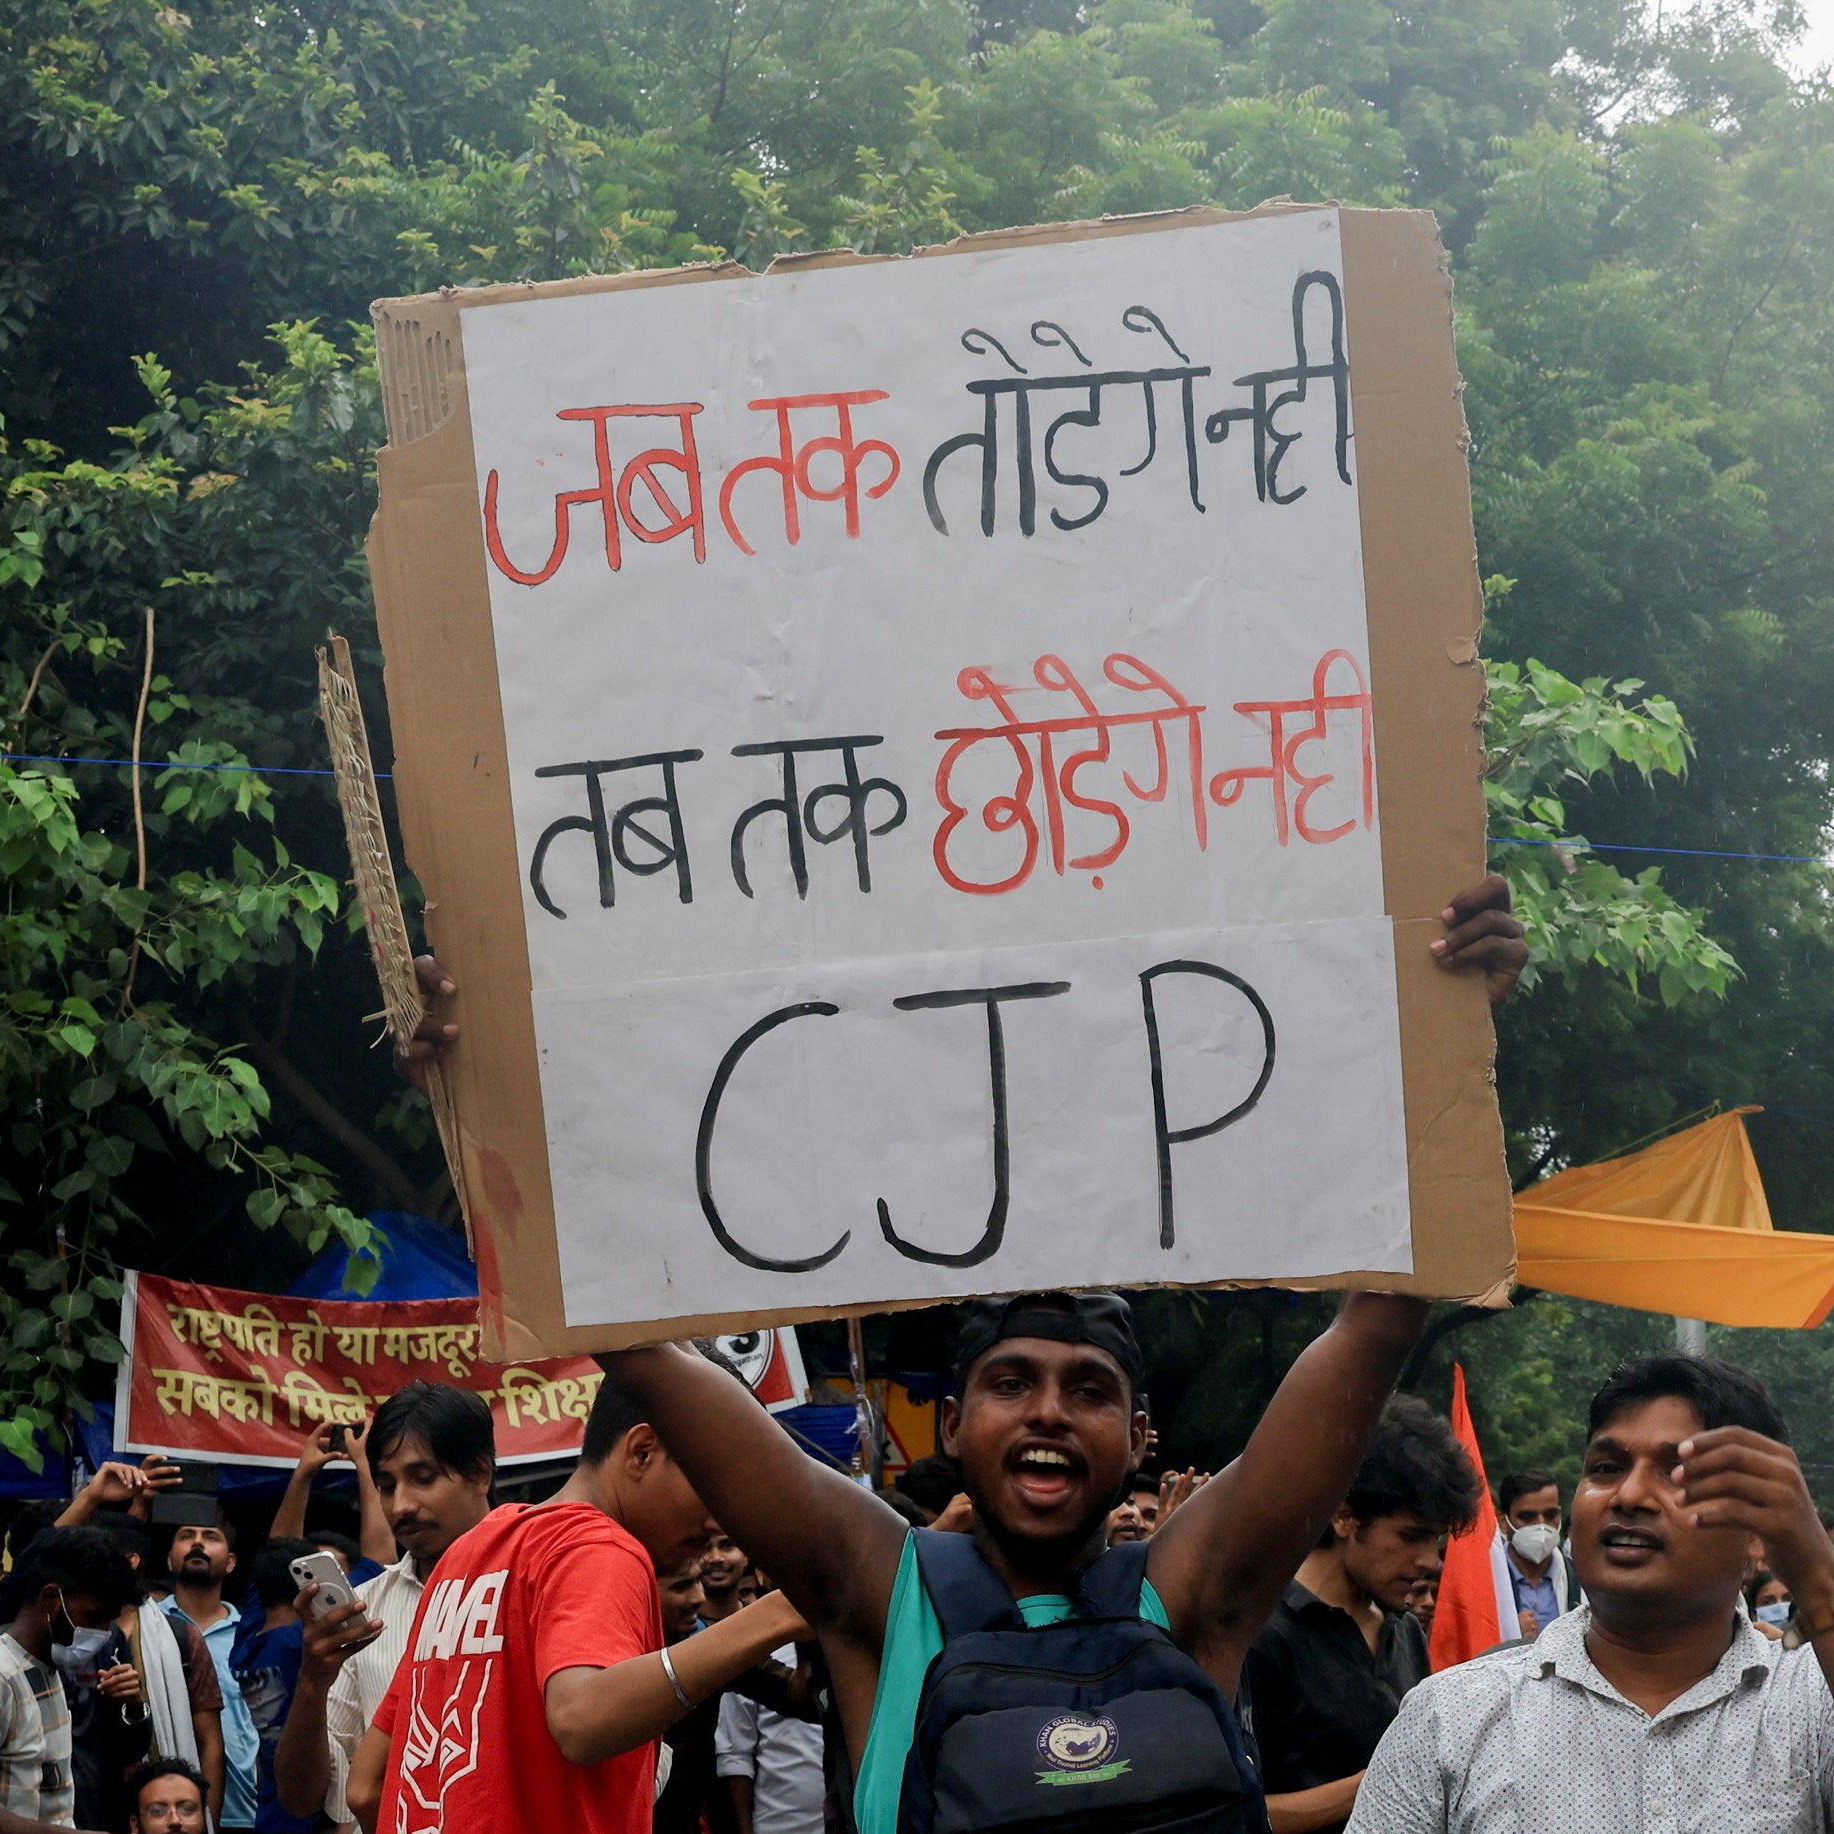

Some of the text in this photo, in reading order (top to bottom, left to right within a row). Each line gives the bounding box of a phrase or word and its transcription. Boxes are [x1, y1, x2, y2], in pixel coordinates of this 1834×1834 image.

[482, 401, 705, 590] जब
[718, 390, 902, 557] तक
[530, 748, 703, 921] तब
[730, 734, 910, 901] तक
[166, 1302, 480, 1378] राष्ट्रपति हो या मजदूर
[151, 1364, 279, 1427] सबको
[1038, 1725, 1053, 1748] KHAN
